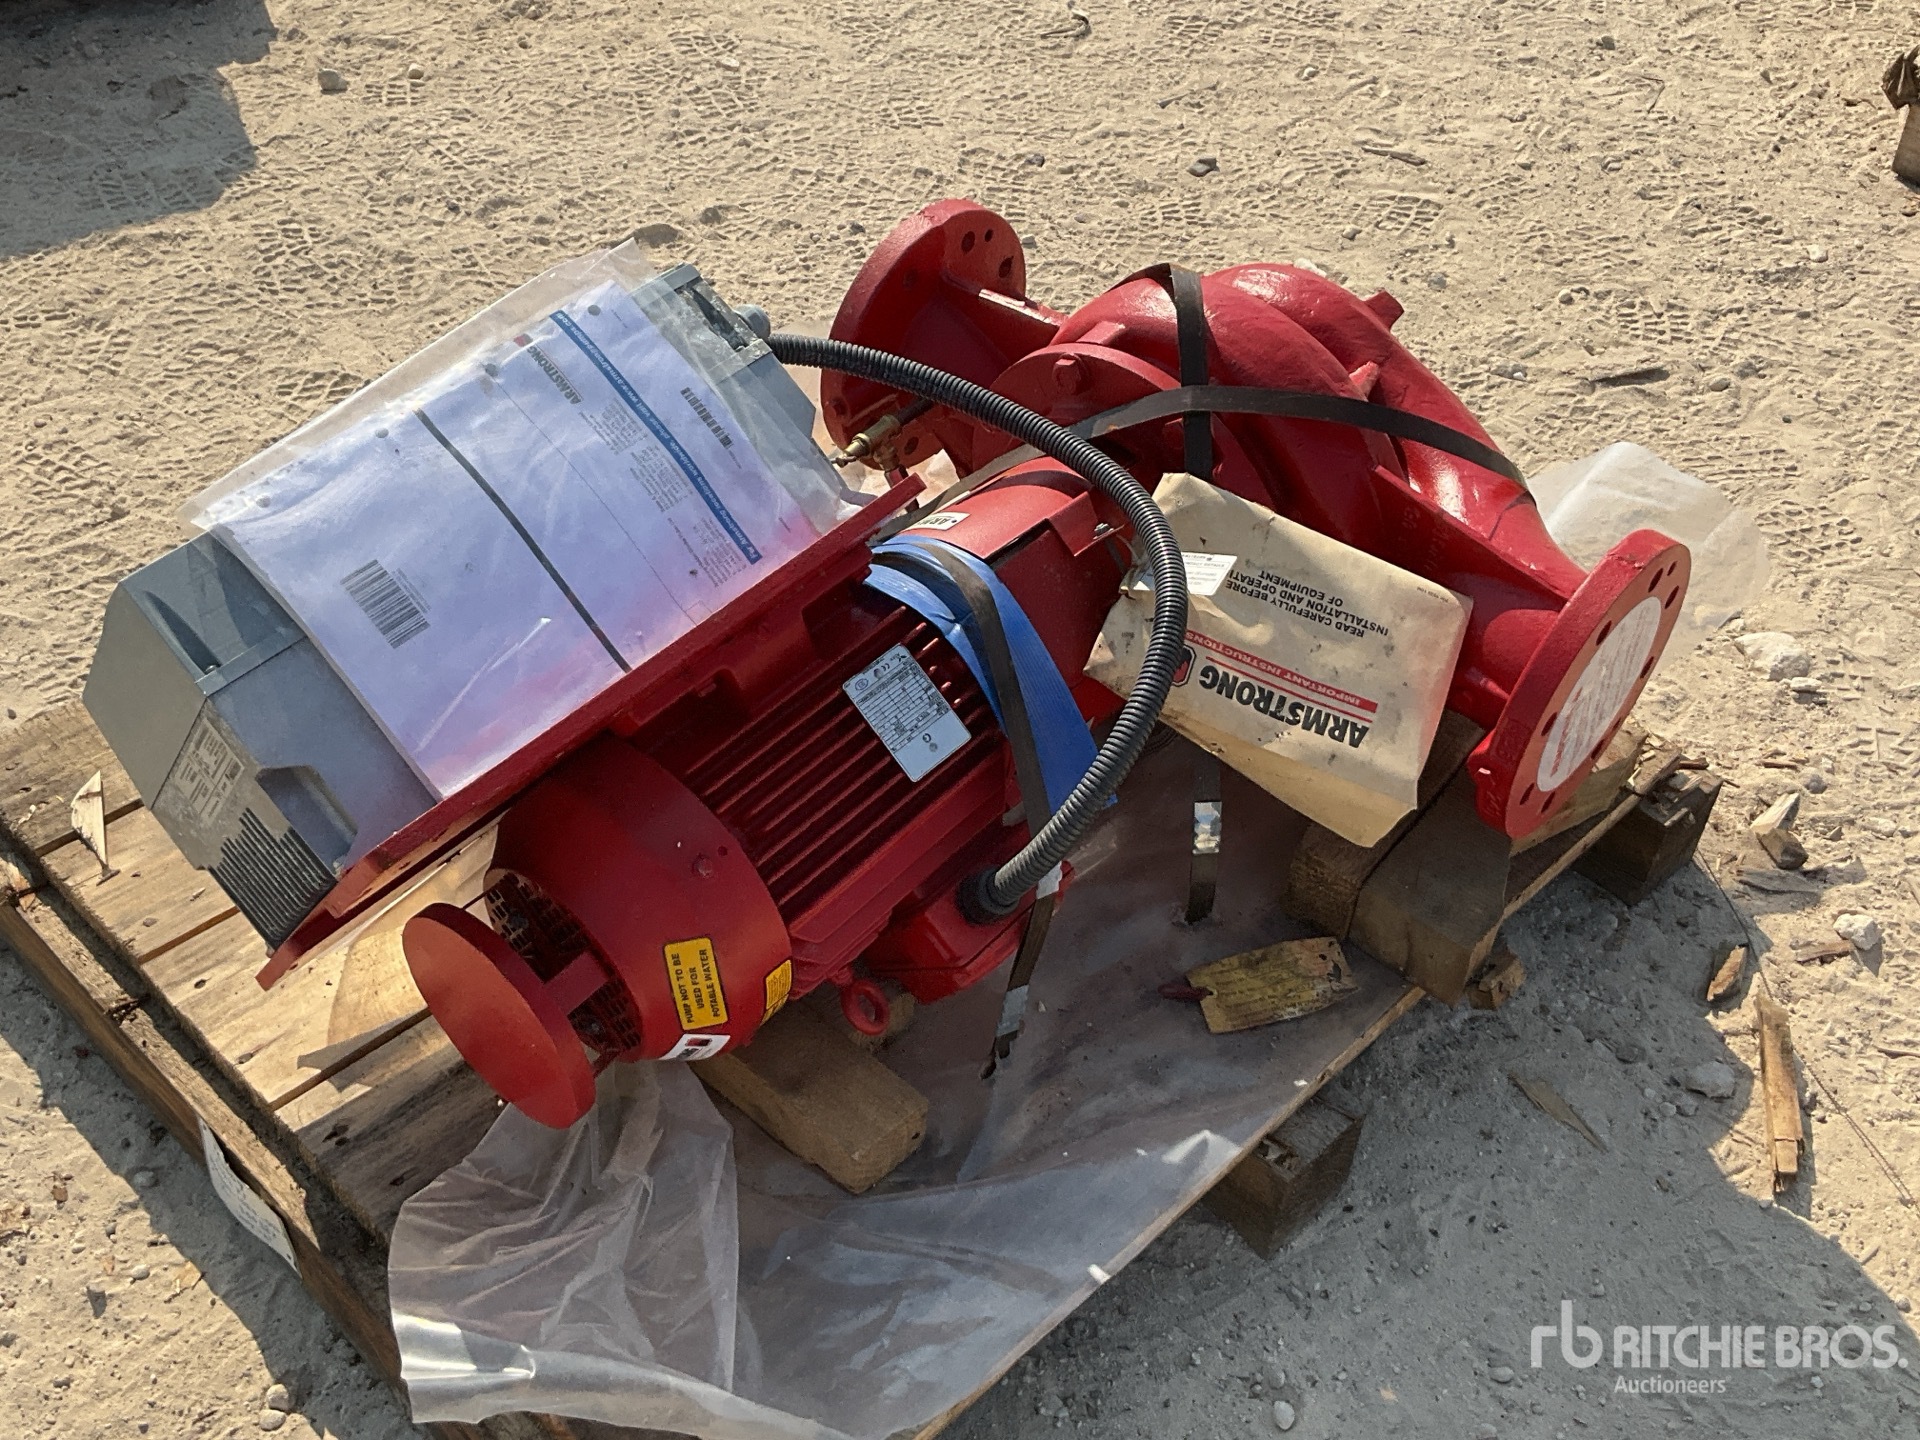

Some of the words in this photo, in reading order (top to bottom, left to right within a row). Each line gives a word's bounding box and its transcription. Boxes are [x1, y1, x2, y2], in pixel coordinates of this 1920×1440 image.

[527, 345, 581, 404] ARMSTRONG
[718, 508, 749, 547] Armstrong
[1224, 579, 1268, 602] BEFORE
[1227, 569, 1277, 594] OPERATI
[1257, 570, 1325, 601] EQUIPMENT
[1278, 588, 1304, 604] AND
[1326, 595, 1343, 607] OF
[1270, 596, 1332, 625] CAREFULLY
[1305, 598, 1388, 635] INSTALLATION
[1334, 620, 1365, 637] READ
[1184, 631, 1281, 675] INSTRUCTIONS
[1282, 670, 1360, 705] IMPORTANT
[1197, 663, 1369, 748] ARMSTRONG
[671, 952, 681, 966] BE
[698, 948, 712, 981] WATER
[674, 968, 684, 981] TO
[688, 966, 699, 985] FOR
[678, 982, 688, 1001] NOT
[692, 986, 704, 1009] USED
[706, 982, 720, 1017] POTABLE
[683, 1002, 694, 1023] PUMP
